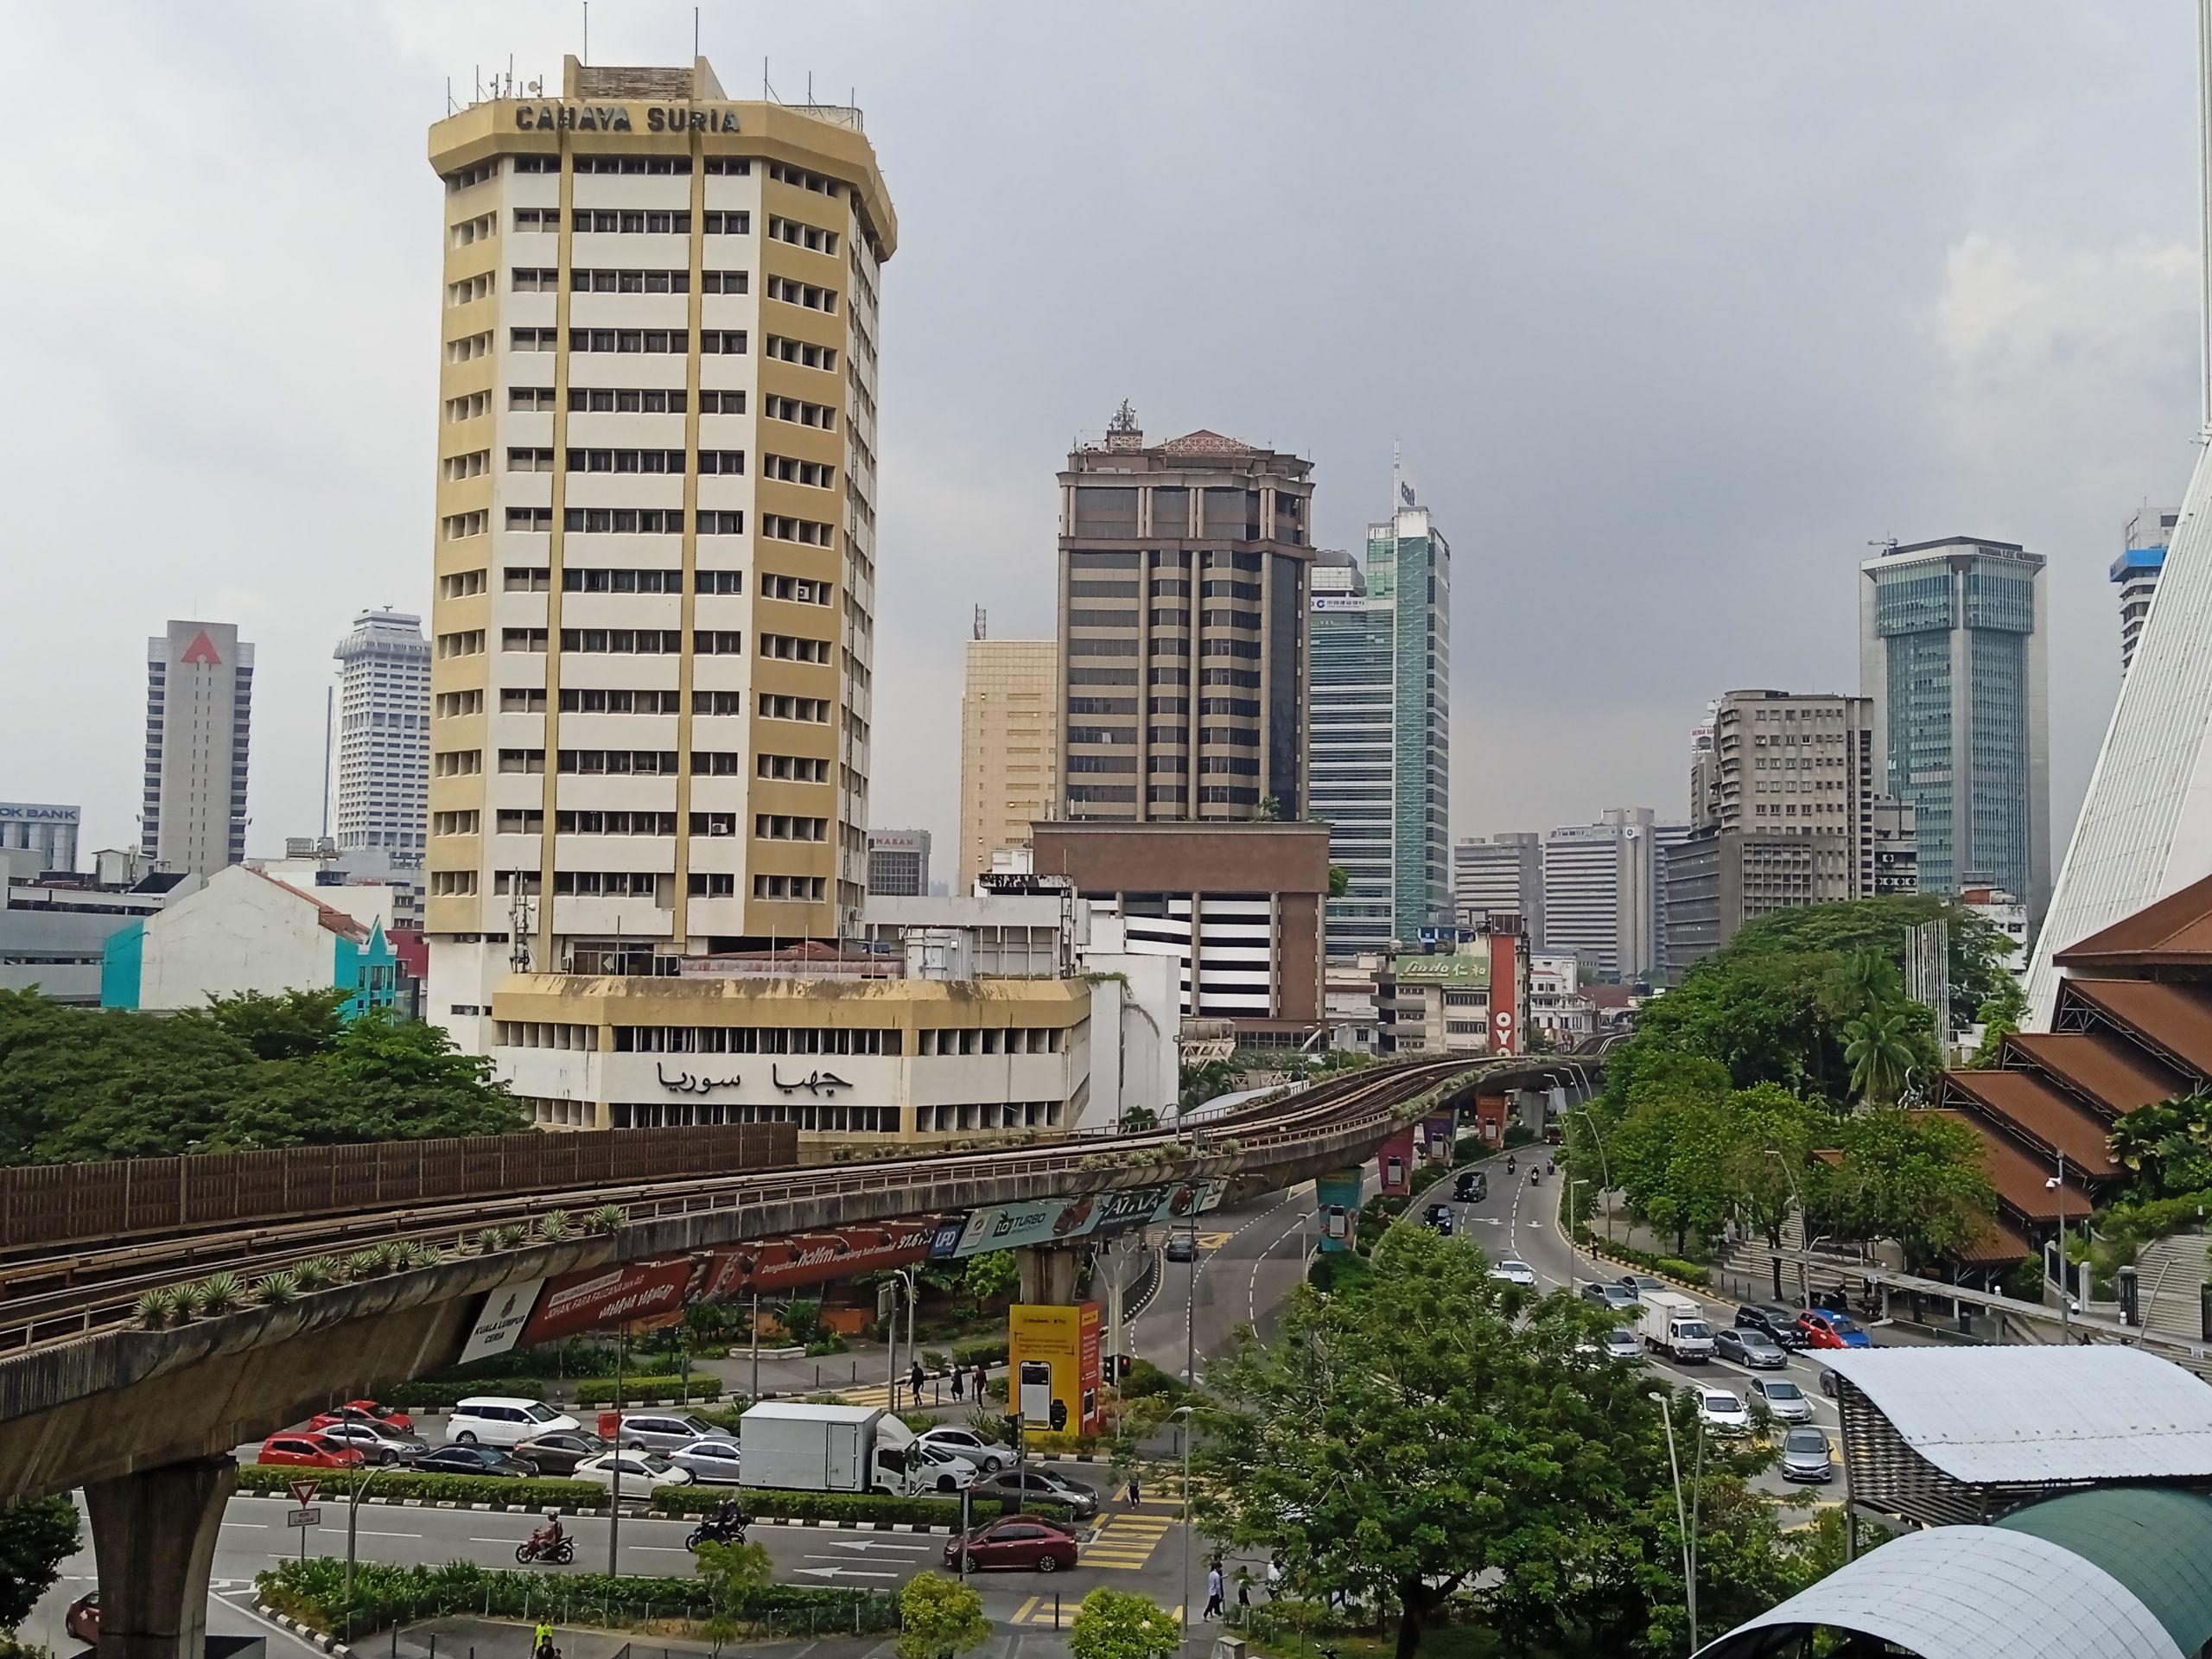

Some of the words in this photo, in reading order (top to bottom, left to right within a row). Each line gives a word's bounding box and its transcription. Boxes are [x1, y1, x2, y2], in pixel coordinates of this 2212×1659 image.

[516, 105, 632, 131] CAHAYA
[647, 106, 740, 133] SURIA
[27, 809, 76, 819] BANK
[1496, 1011, 1512, 1057] OYO
[657, 1061, 741, 1095] سوريا
[1013, 1213, 1046, 1228] TURBO
[474, 1322, 499, 1336] KUALA
[497, 1315, 526, 1330] LUMPUR
